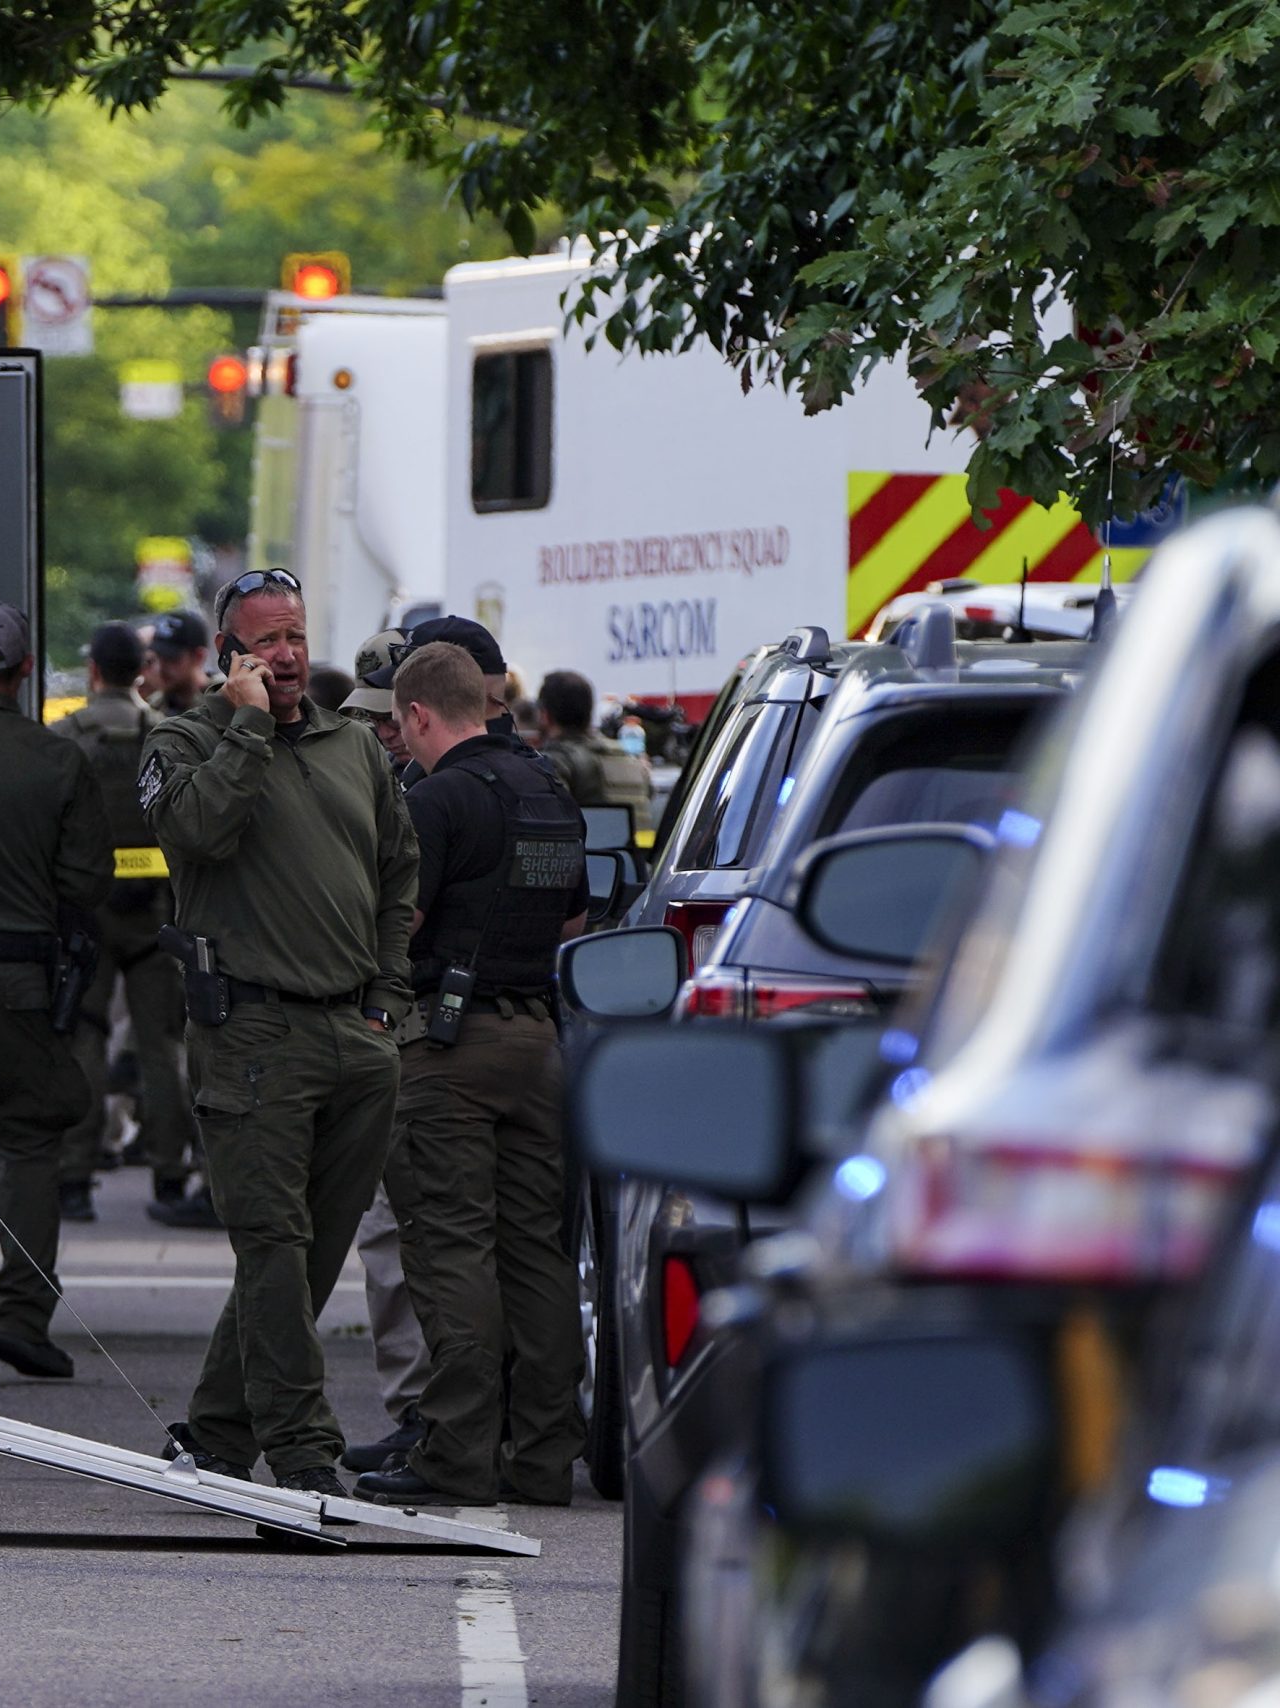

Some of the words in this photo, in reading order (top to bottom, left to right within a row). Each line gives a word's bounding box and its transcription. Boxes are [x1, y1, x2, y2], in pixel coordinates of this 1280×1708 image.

[539, 542, 619, 586] BOULDER
[622, 532, 726, 578] EMERGENCY
[730, 526, 791, 577] SQUAD
[608, 597, 717, 662] SARCOM
[516, 841, 555, 857] BOULDER
[521, 857, 577, 872] SHERIFF
[526, 872, 570, 888] SWAT
